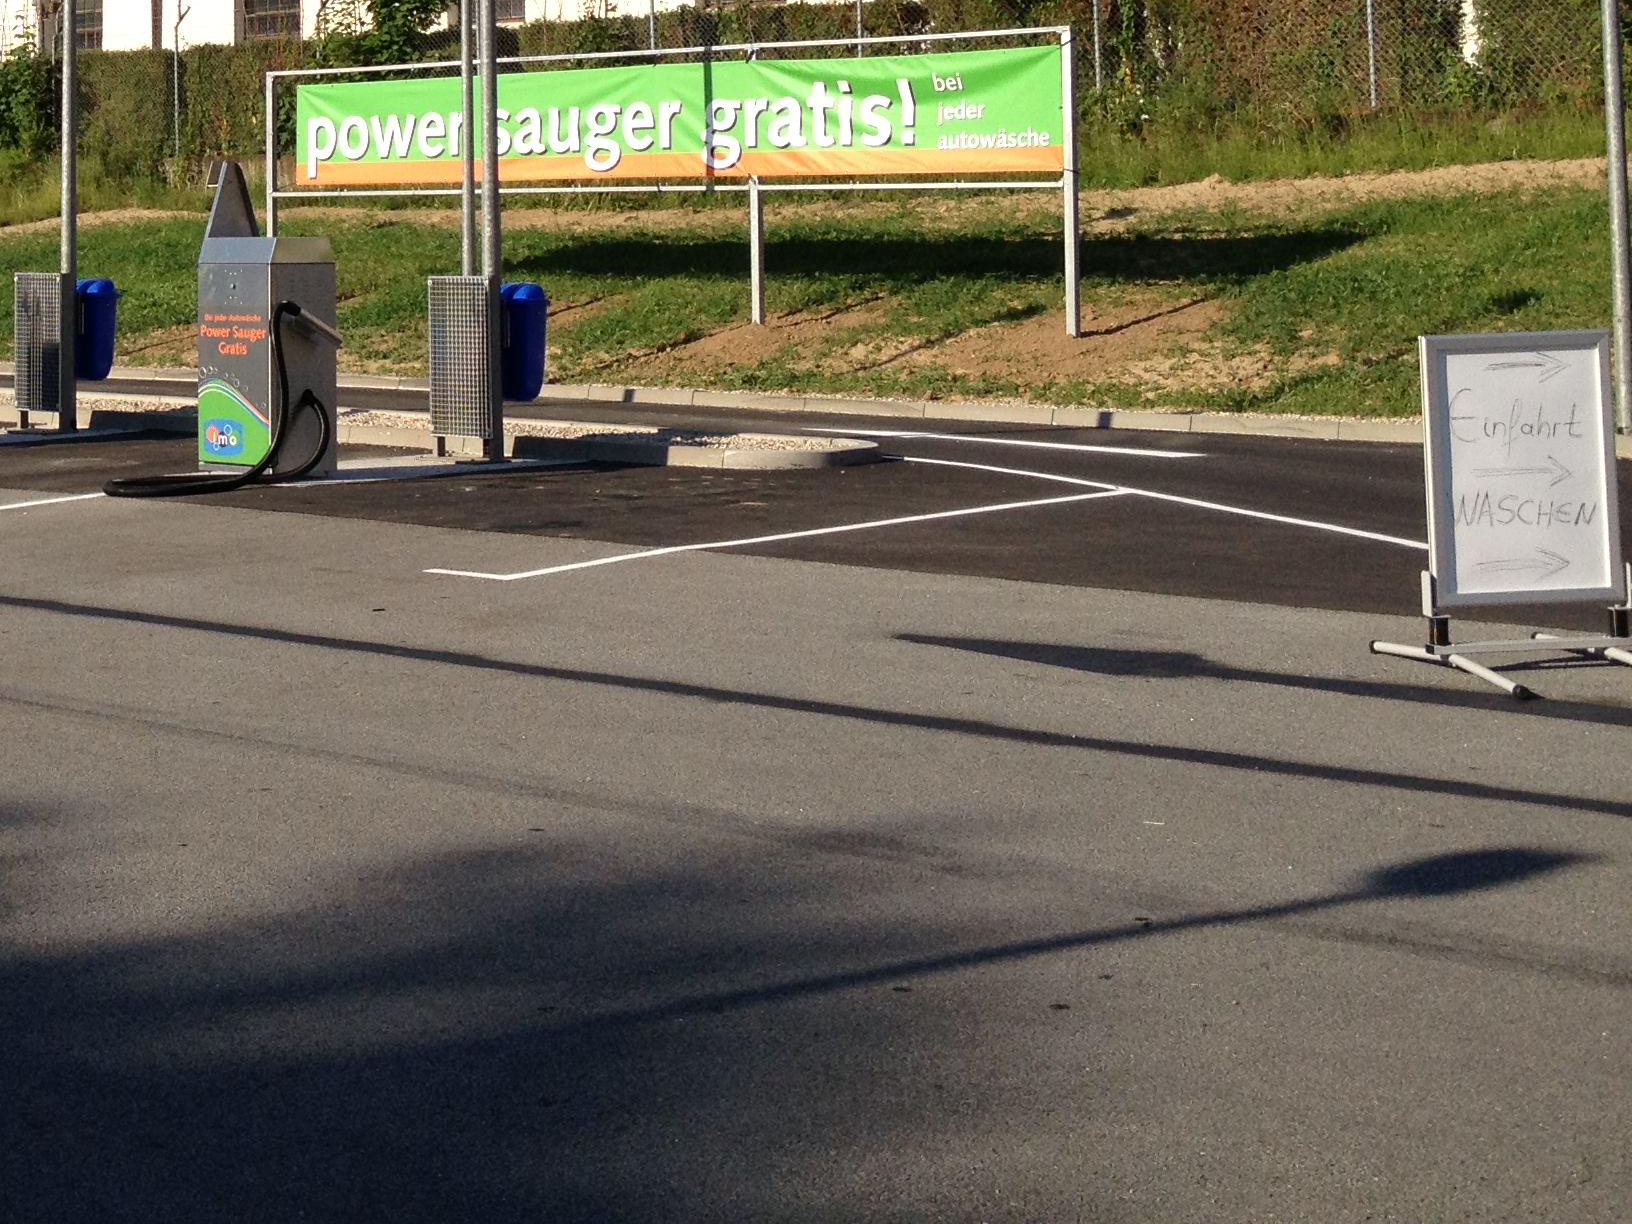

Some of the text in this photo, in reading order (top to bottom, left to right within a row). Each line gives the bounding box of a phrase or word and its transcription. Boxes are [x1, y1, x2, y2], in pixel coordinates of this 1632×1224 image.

[932, 72, 964, 92] bei
[937, 99, 986, 126] jeder
[307, 111, 463, 179] power
[701, 78, 917, 170] gratis!
[937, 126, 1050, 150] autowäsche
[200, 324, 267, 343] Power Sauger
[218, 341, 248, 355] Gratis
[1449, 388, 1583, 459] Einfahrt
